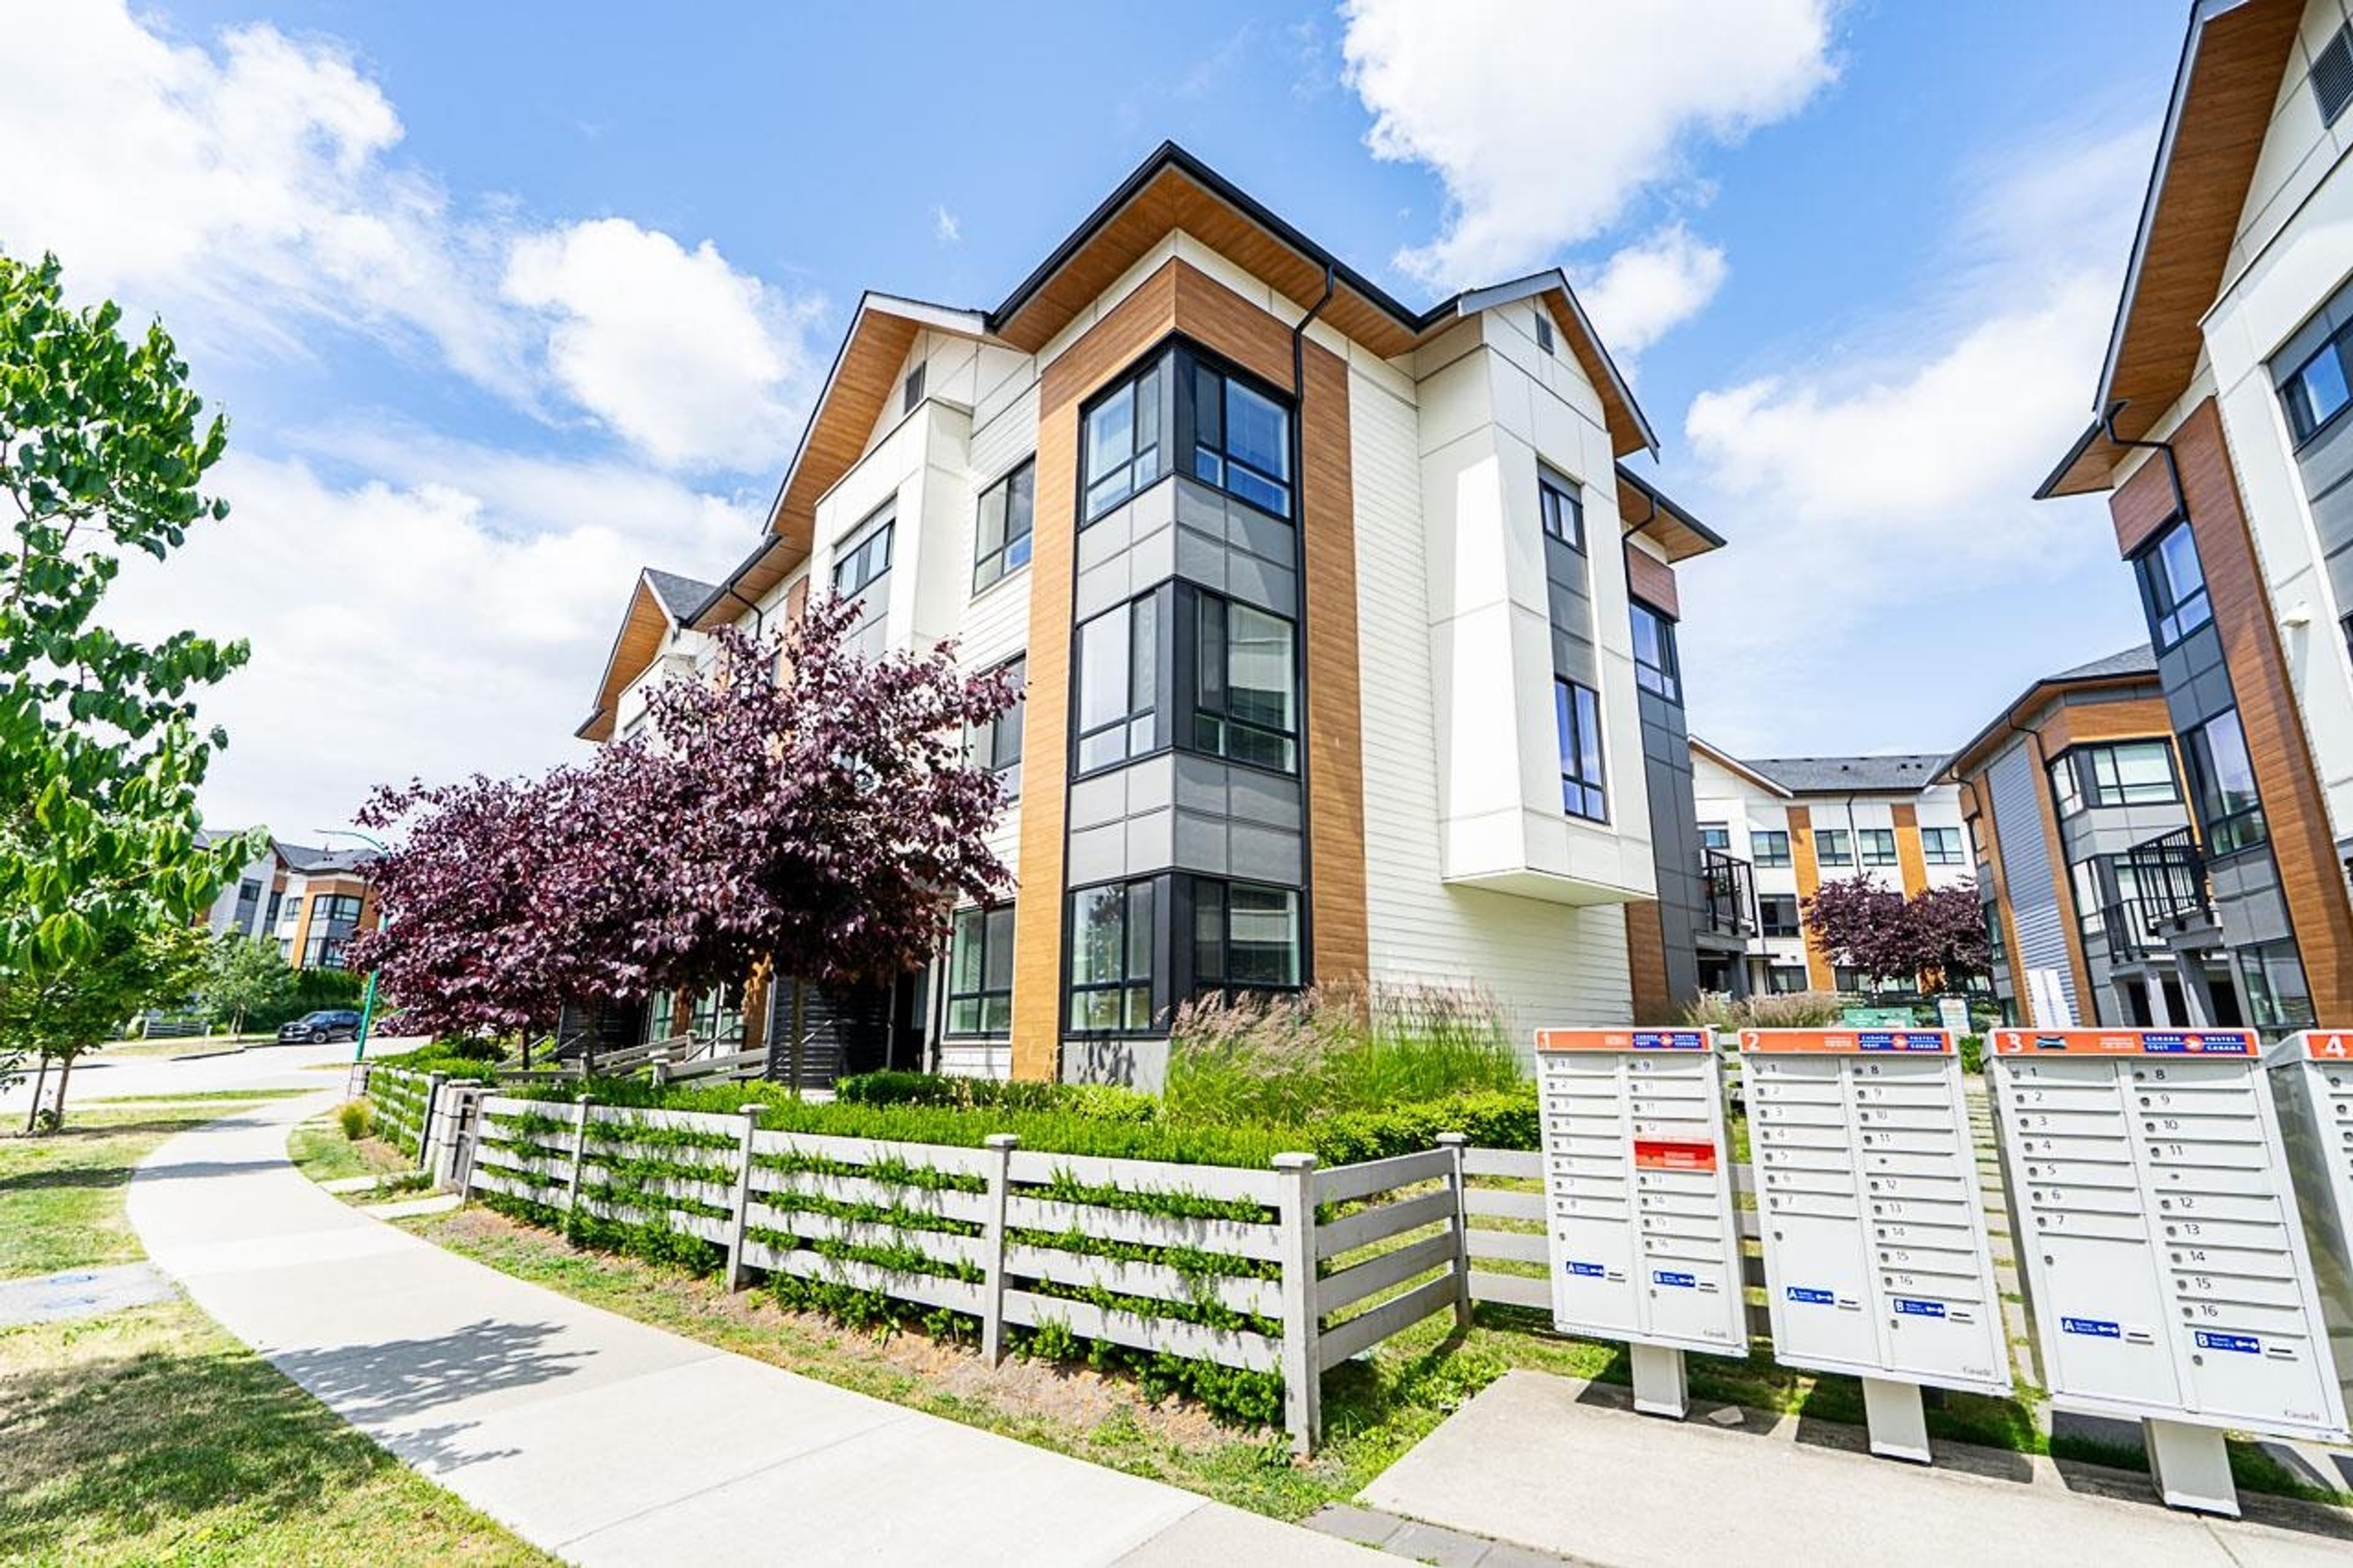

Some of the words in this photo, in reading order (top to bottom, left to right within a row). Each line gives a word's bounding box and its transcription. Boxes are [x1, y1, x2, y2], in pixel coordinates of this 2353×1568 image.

[1542, 1032, 1550, 1049] 1
[1747, 1033, 1760, 1050] 2
[2007, 1033, 2023, 1052] 3
[2326, 1035, 2347, 1058] 4
[1870, 1064, 1879, 1074] 8
[2156, 1069, 2165, 1080] 8
[2161, 1093, 2170, 1104] 9
[2039, 1116, 2047, 1126] 3
[2164, 1119, 2178, 1130] 10
[2043, 1140, 2051, 1149] 4
[2169, 1145, 2183, 1156] 11
[2047, 1165, 2056, 1175] 5
[2052, 1189, 2061, 1200] 6
[2180, 1197, 2195, 1208] 12
[2056, 1214, 2064, 1224] 7
[2183, 1224, 2200, 1235] 13
[2190, 1250, 2206, 1262] 14
[2195, 1277, 2211, 1289] 15
[1789, 1288, 1797, 1299] A
[1895, 1300, 1904, 1312] B
[2200, 1305, 2218, 1317] 16
[2064, 1319, 2075, 1332] A
[2198, 1333, 2209, 1347] B
